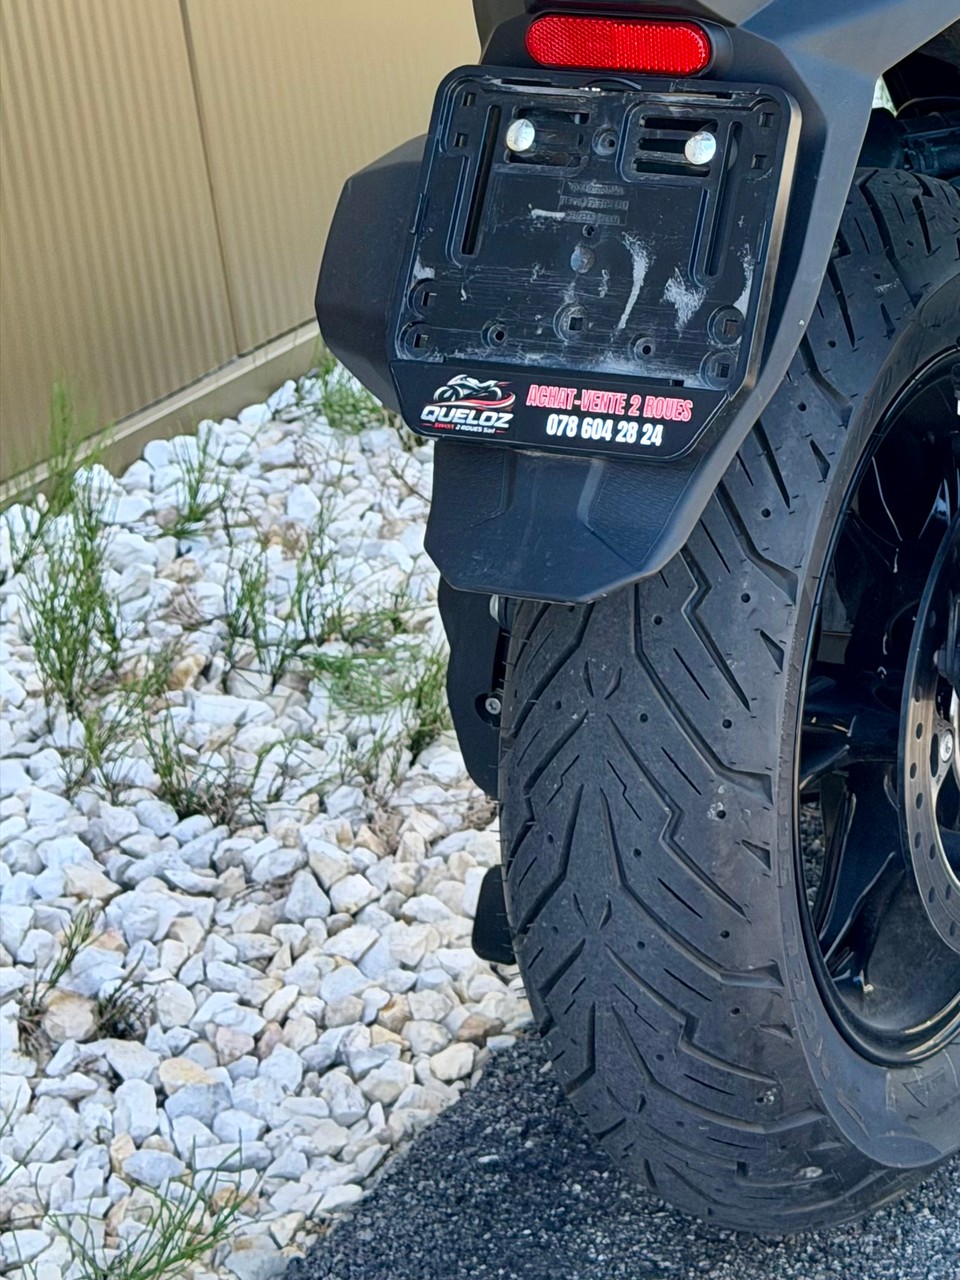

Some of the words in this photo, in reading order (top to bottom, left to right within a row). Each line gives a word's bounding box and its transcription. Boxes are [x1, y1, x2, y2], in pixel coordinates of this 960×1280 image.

[420, 405, 514, 428] QUELOZ
[526, 384, 628, 416] ACHAT-VENTE
[628, 394, 642, 417] 2
[643, 395, 694, 422] ROUES
[461, 425, 482, 433] ROUES
[546, 413, 579, 438] 078
[580, 417, 614, 442] 604
[615, 420, 639, 444] 28
[640, 423, 664, 447] 24
